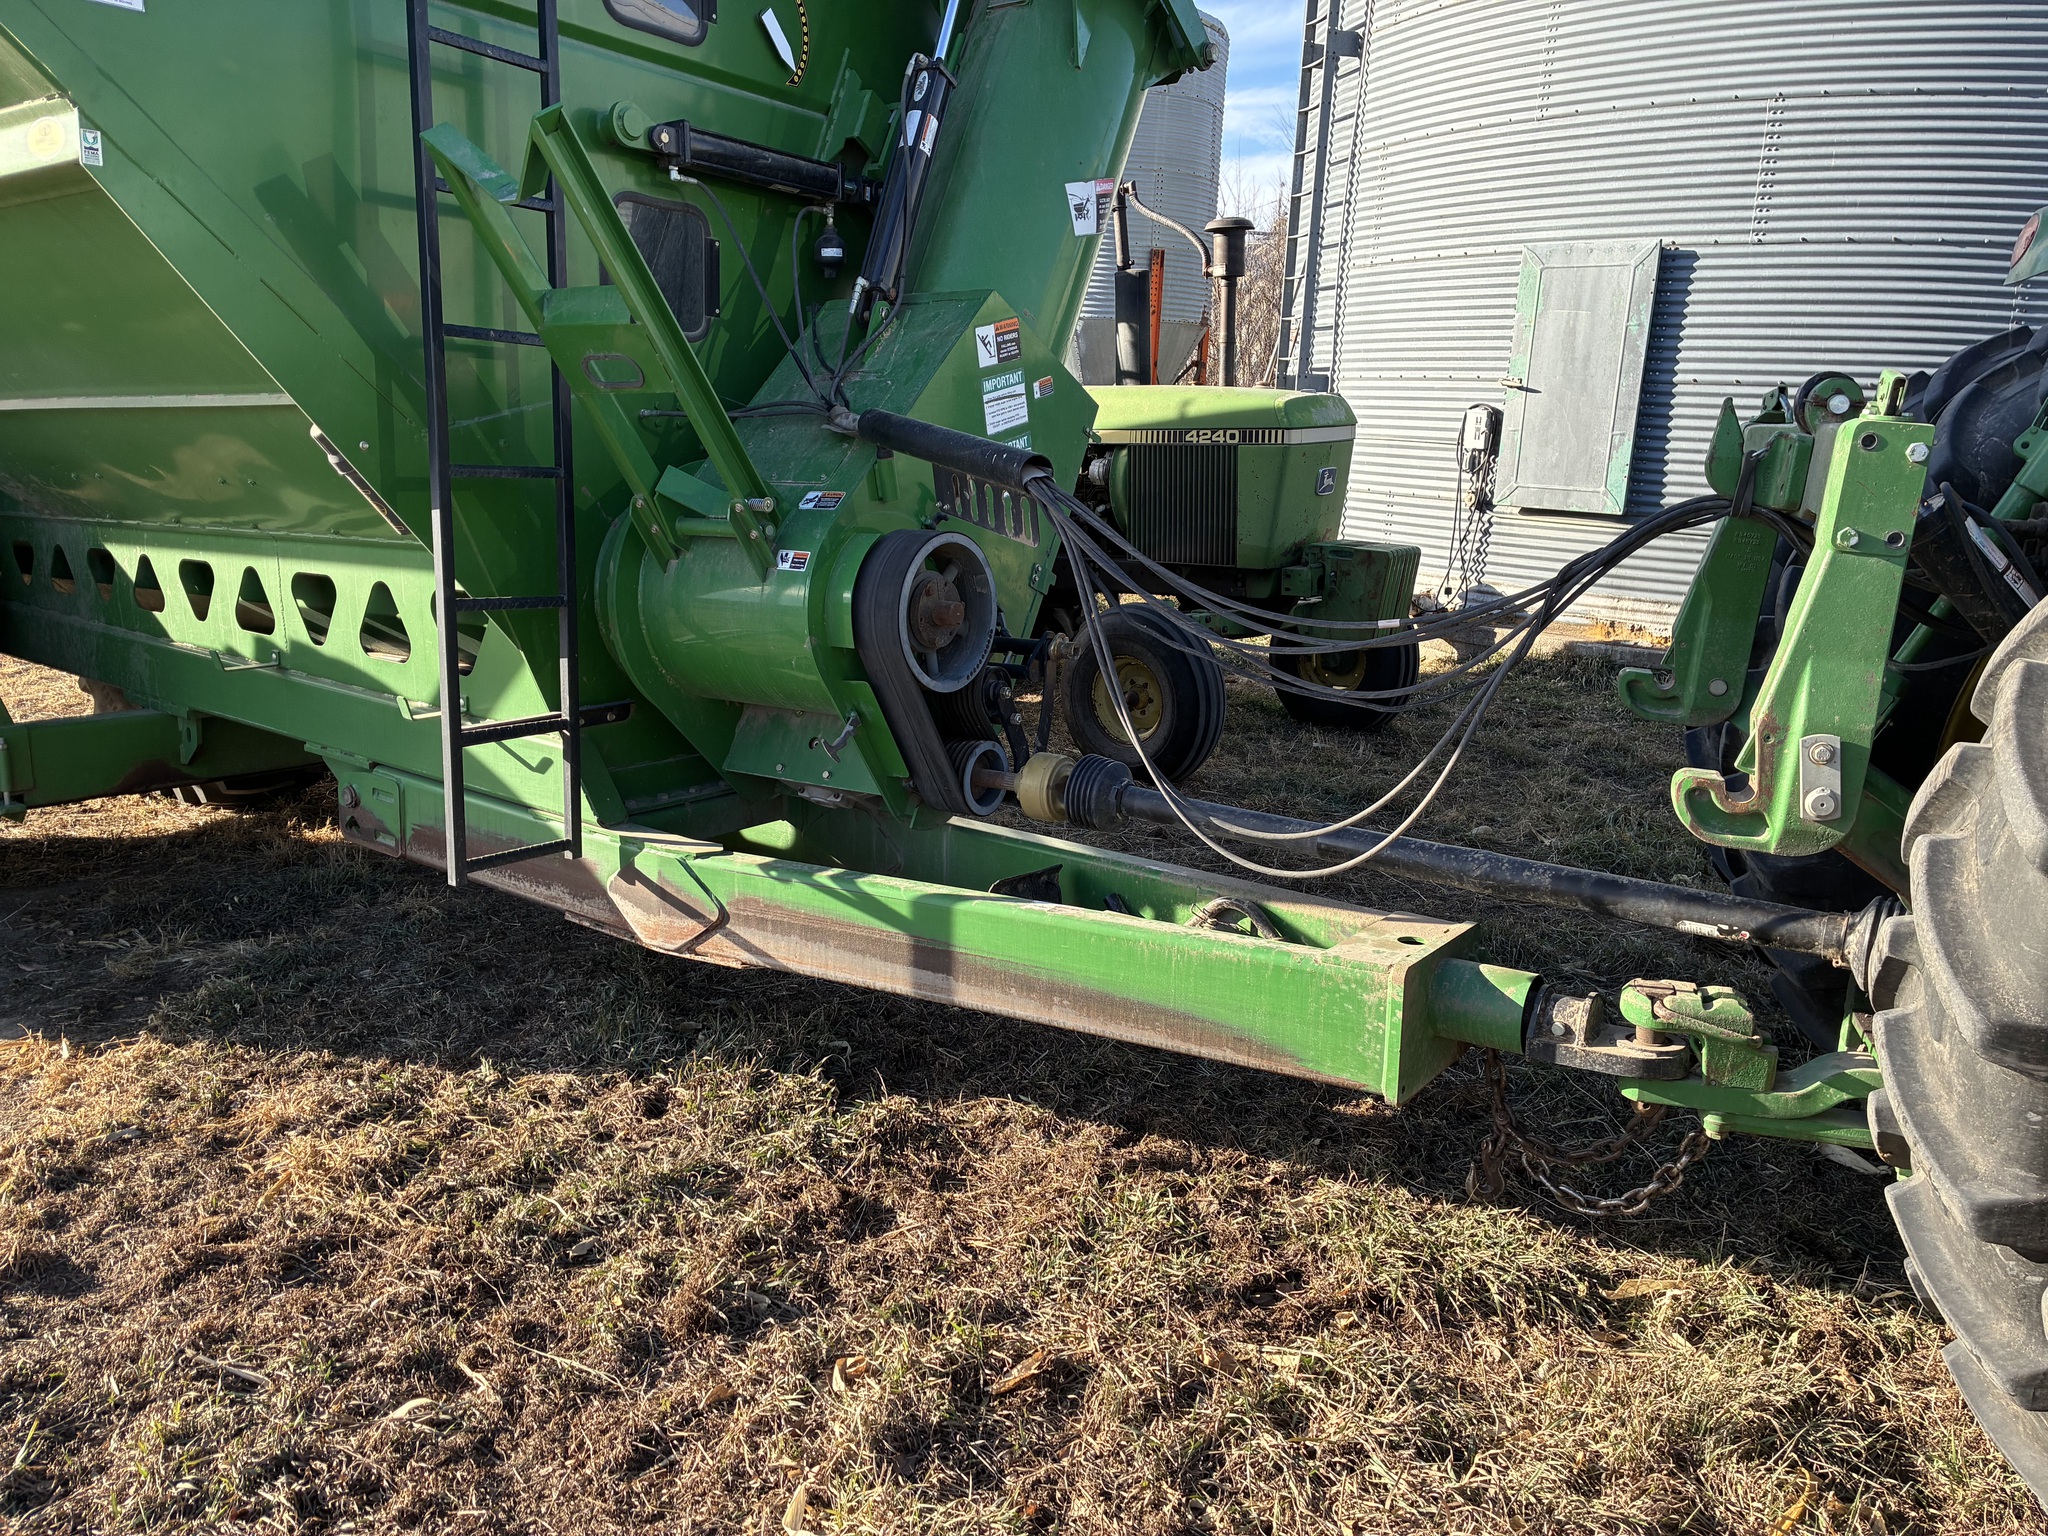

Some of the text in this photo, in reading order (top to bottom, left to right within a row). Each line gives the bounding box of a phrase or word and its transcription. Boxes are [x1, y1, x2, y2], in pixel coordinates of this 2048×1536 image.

[997, 331, 1018, 343] NO RIDERS
[983, 371, 1022, 392] IMPORTANT
[1185, 430, 1239, 444] 4240
